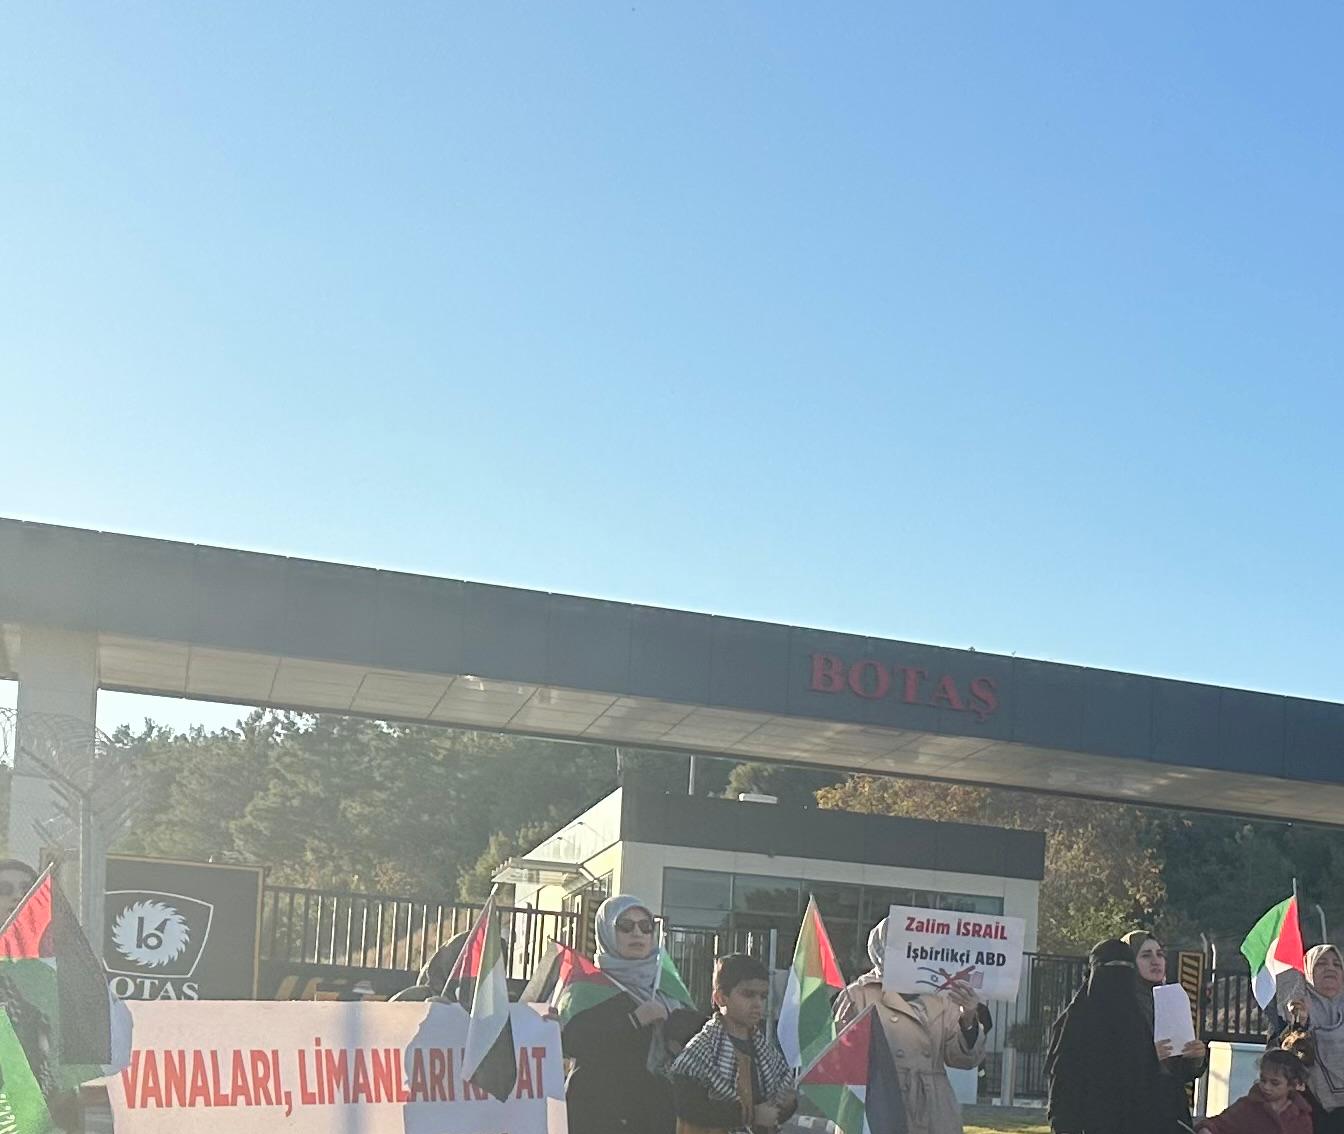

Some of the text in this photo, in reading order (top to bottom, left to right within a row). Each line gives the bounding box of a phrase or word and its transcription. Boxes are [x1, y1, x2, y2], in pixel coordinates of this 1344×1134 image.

[809, 652, 999, 720] BOTAŞ
[905, 917, 1008, 940] Zalim İSRAİL
[906, 942, 1007, 967] İşbirlikçi ABD
[120, 1048, 293, 1117] VANALARI,
[298, 1036, 455, 1105] LİMANLARI
